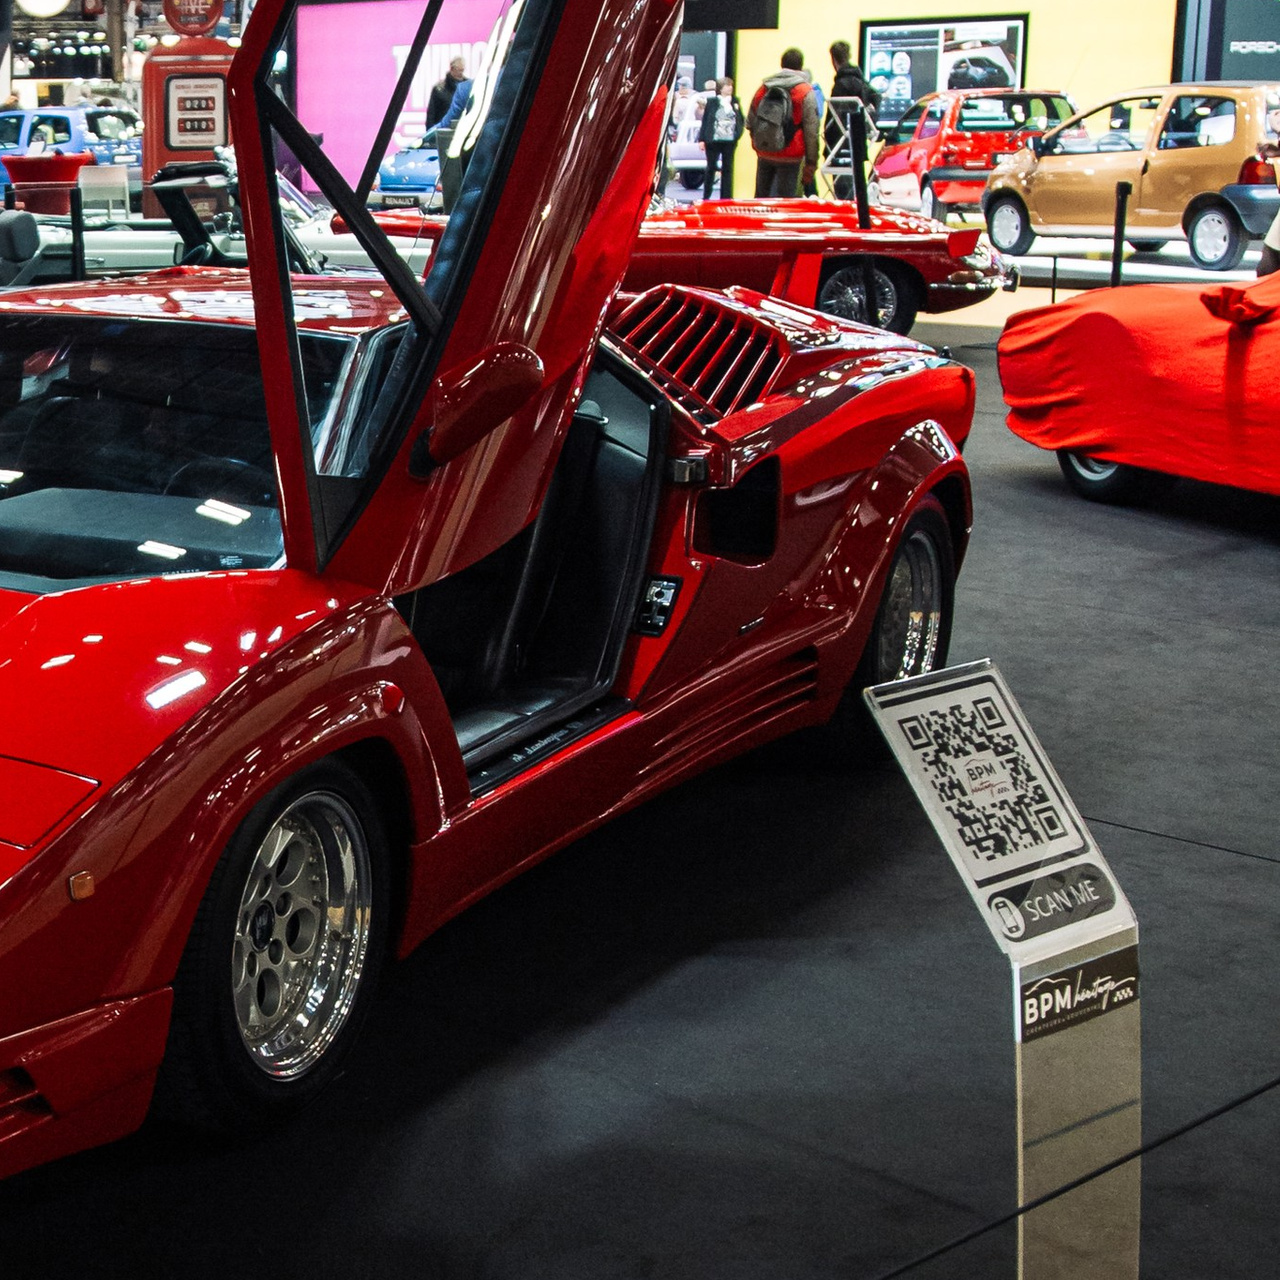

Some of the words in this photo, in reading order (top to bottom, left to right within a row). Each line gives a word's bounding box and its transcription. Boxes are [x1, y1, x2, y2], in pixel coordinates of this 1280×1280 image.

[385, 197, 414, 205] RENAULT
[966, 762, 997, 781] BPM
[1024, 888, 1072, 921] SCAN
[1070, 880, 1100, 905] ME
[1025, 985, 1071, 1024] BPM
